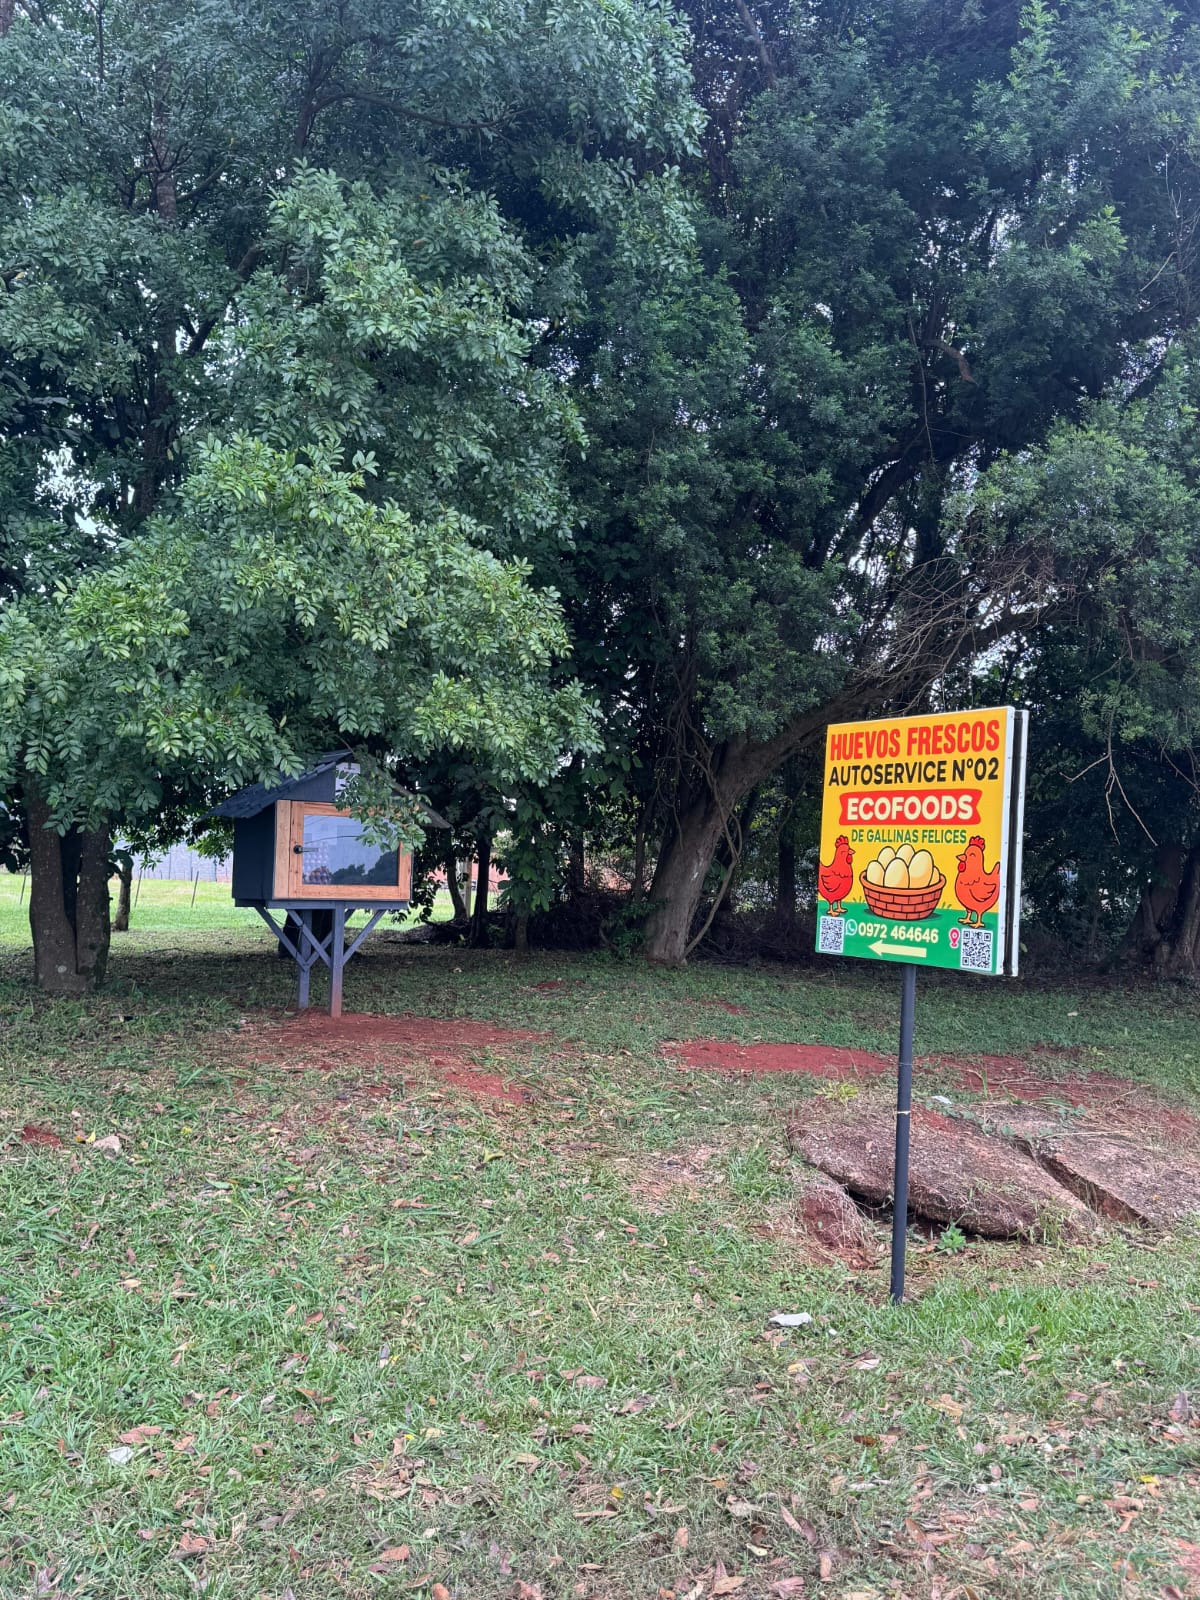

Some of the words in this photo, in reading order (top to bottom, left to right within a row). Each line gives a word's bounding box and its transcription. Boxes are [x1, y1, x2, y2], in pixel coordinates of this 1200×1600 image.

[830, 729, 900, 760] HUEVOS
[907, 720, 1000, 755] FRESCOS
[829, 761, 947, 786] AUTOSERVICE
[847, 794, 973, 820] ECOFOODS
[851, 829, 864, 842] DE
[867, 829, 918, 843] GALLINAS
[922, 830, 967, 844] FELICES
[858, 922, 887, 938] 0972
[890, 925, 939, 943] 464646
